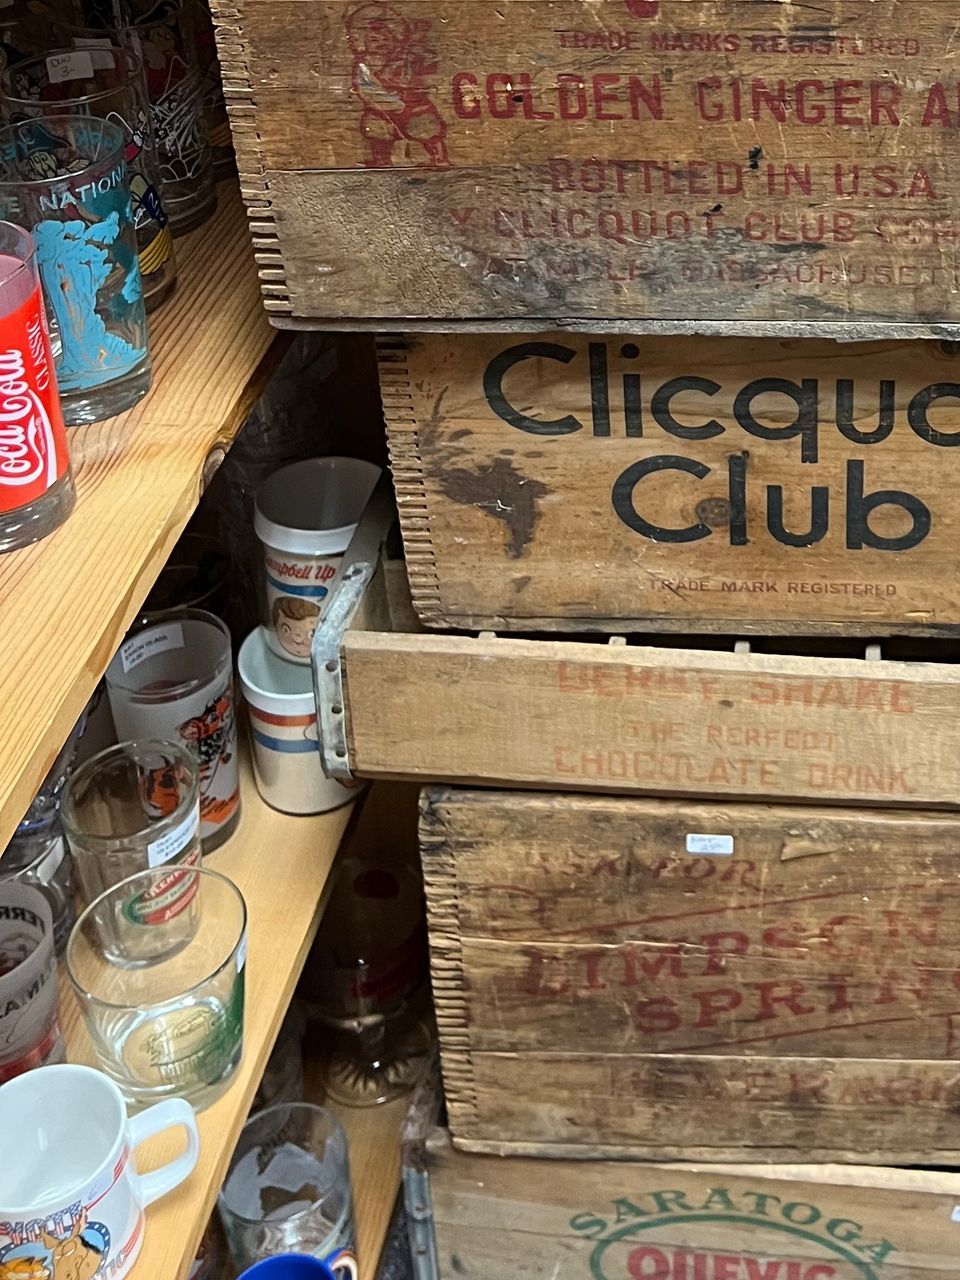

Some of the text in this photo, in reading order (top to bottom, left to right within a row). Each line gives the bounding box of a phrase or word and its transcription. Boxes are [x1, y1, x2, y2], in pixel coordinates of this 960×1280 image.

[558, 30, 921, 57] TRADE MARKS REGISTERED
[451, 72, 664, 122] GOLDEN
[697, 78, 903, 126] GINGER
[548, 156, 743, 196] BOTTLED
[766, 162, 812, 197] IN
[493, 207, 726, 244] CLICQUOT
[745, 210, 857, 244] CLUB
[611, 449, 932, 552] Club
[648, 578, 899, 597] TRADE MARK REGISTERED
[750, 676, 916, 714] SHAKE
[628, 722, 839, 753] THE PERFECT
[553, 745, 913, 794] CHOCOLATE DRINK
[569, 1187, 899, 1269] SARATOGA
